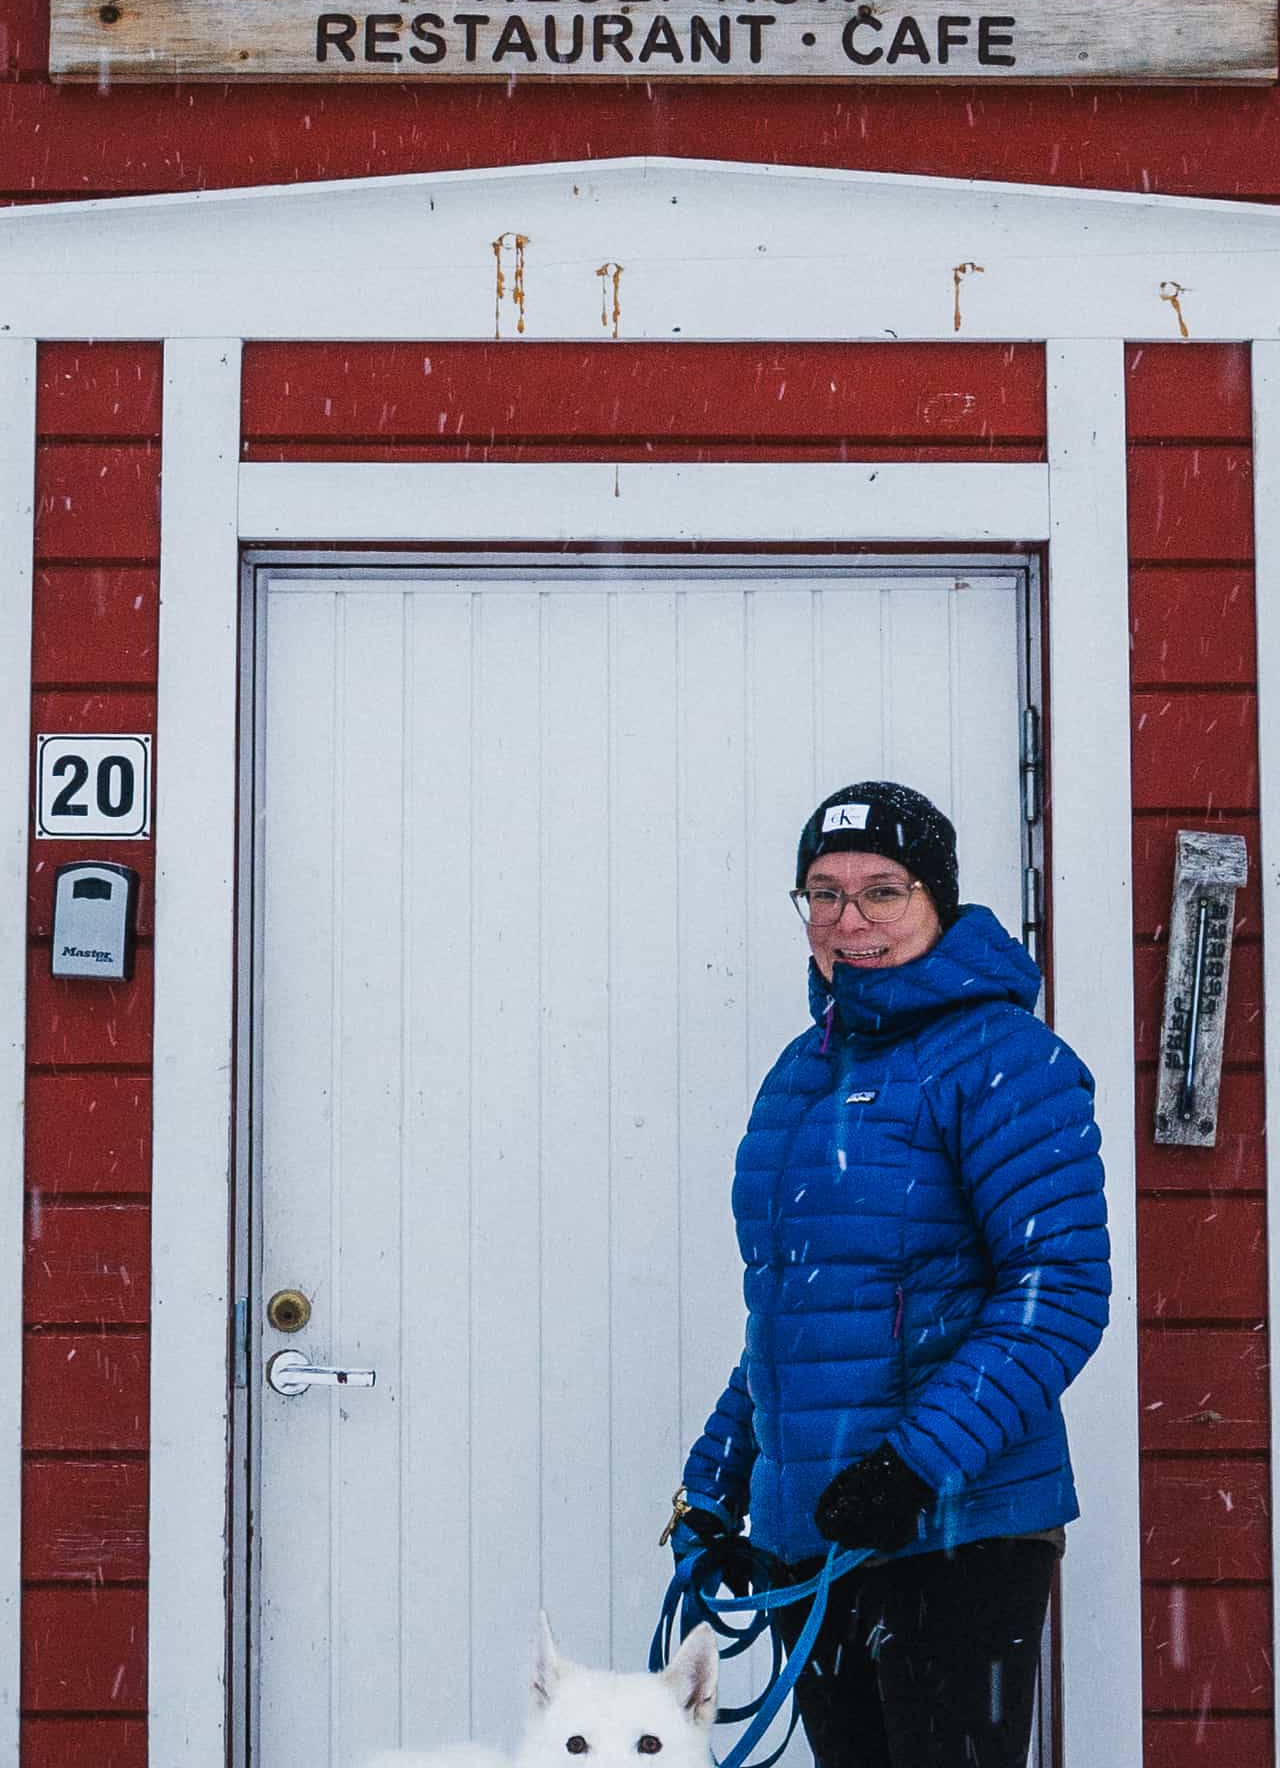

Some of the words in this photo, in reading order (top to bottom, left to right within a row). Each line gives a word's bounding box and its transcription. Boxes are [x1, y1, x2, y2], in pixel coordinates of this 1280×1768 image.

[316, 12, 777, 64] RESTAURANT
[841, 14, 1017, 67] CAFE
[51, 754, 135, 818] 20
[61, 946, 112, 958] Master
